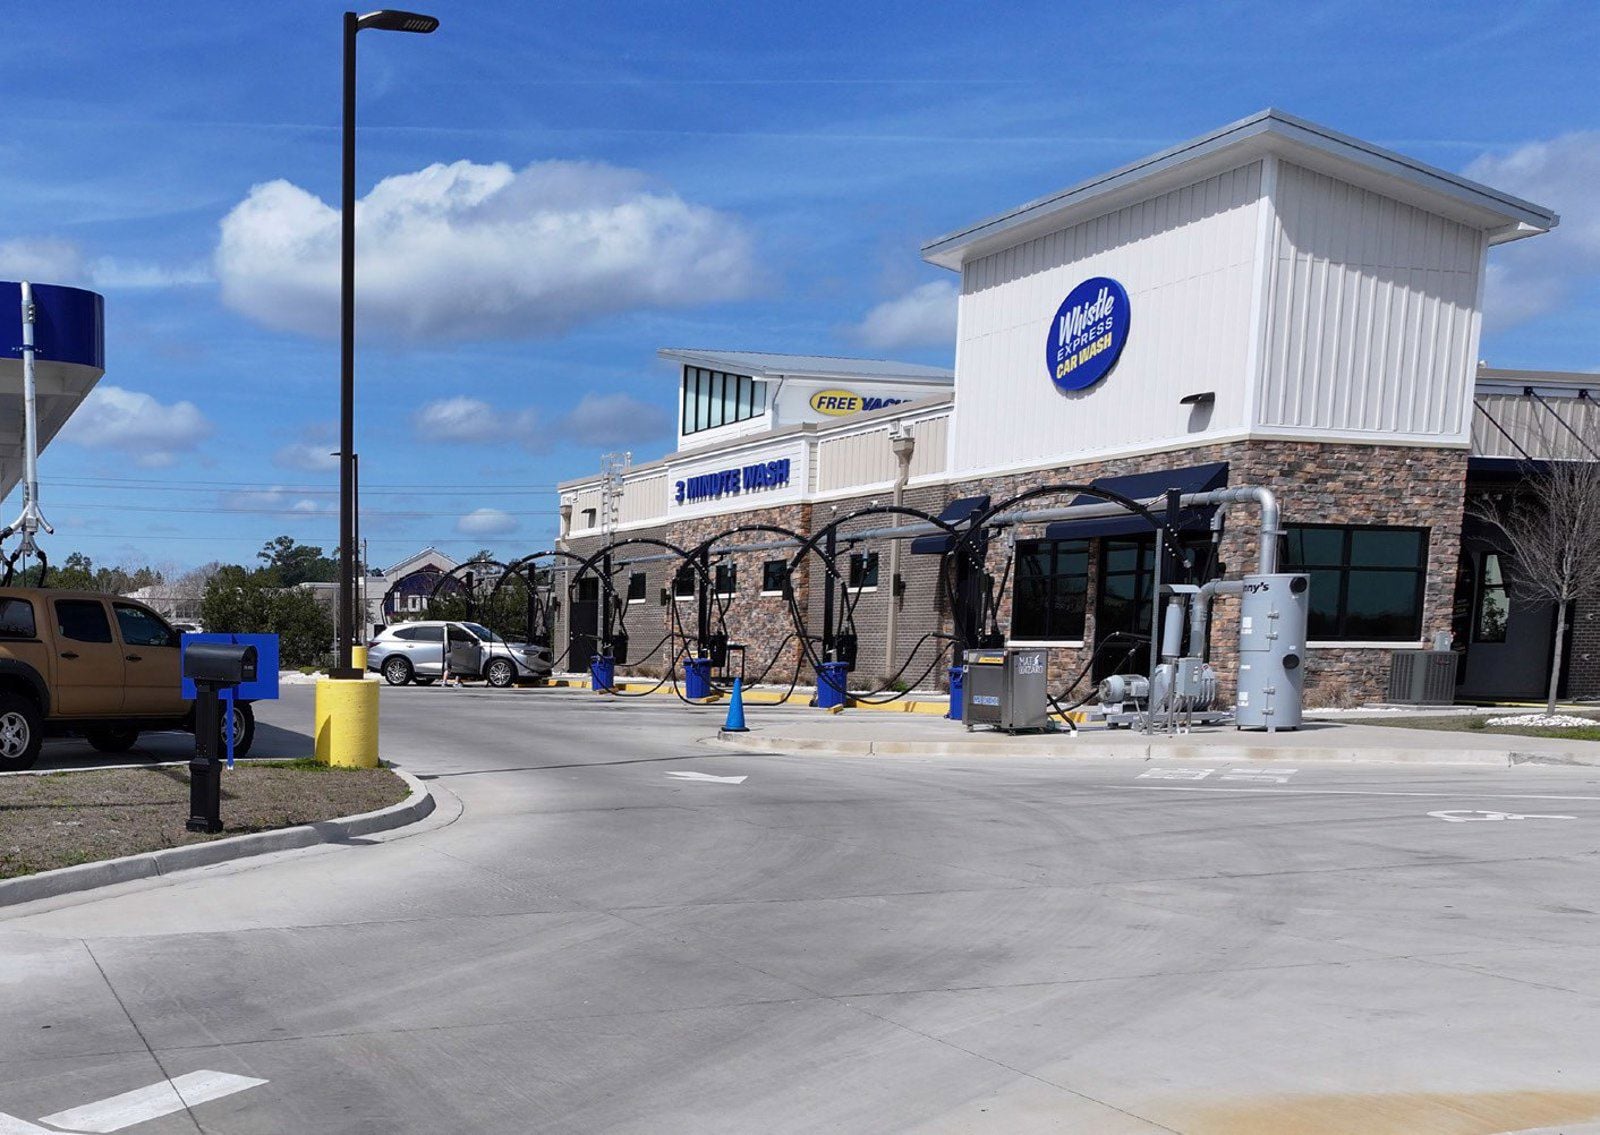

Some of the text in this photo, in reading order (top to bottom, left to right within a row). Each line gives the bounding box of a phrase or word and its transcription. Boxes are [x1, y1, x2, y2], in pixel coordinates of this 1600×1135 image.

[1057, 316, 1113, 361] EXPRESS
[1058, 287, 1115, 347] Whistle
[1056, 332, 1112, 379] CAR WASH
[816, 396, 857, 410] FREE
[675, 480, 685, 502] 3
[687, 468, 741, 500] MINUTE
